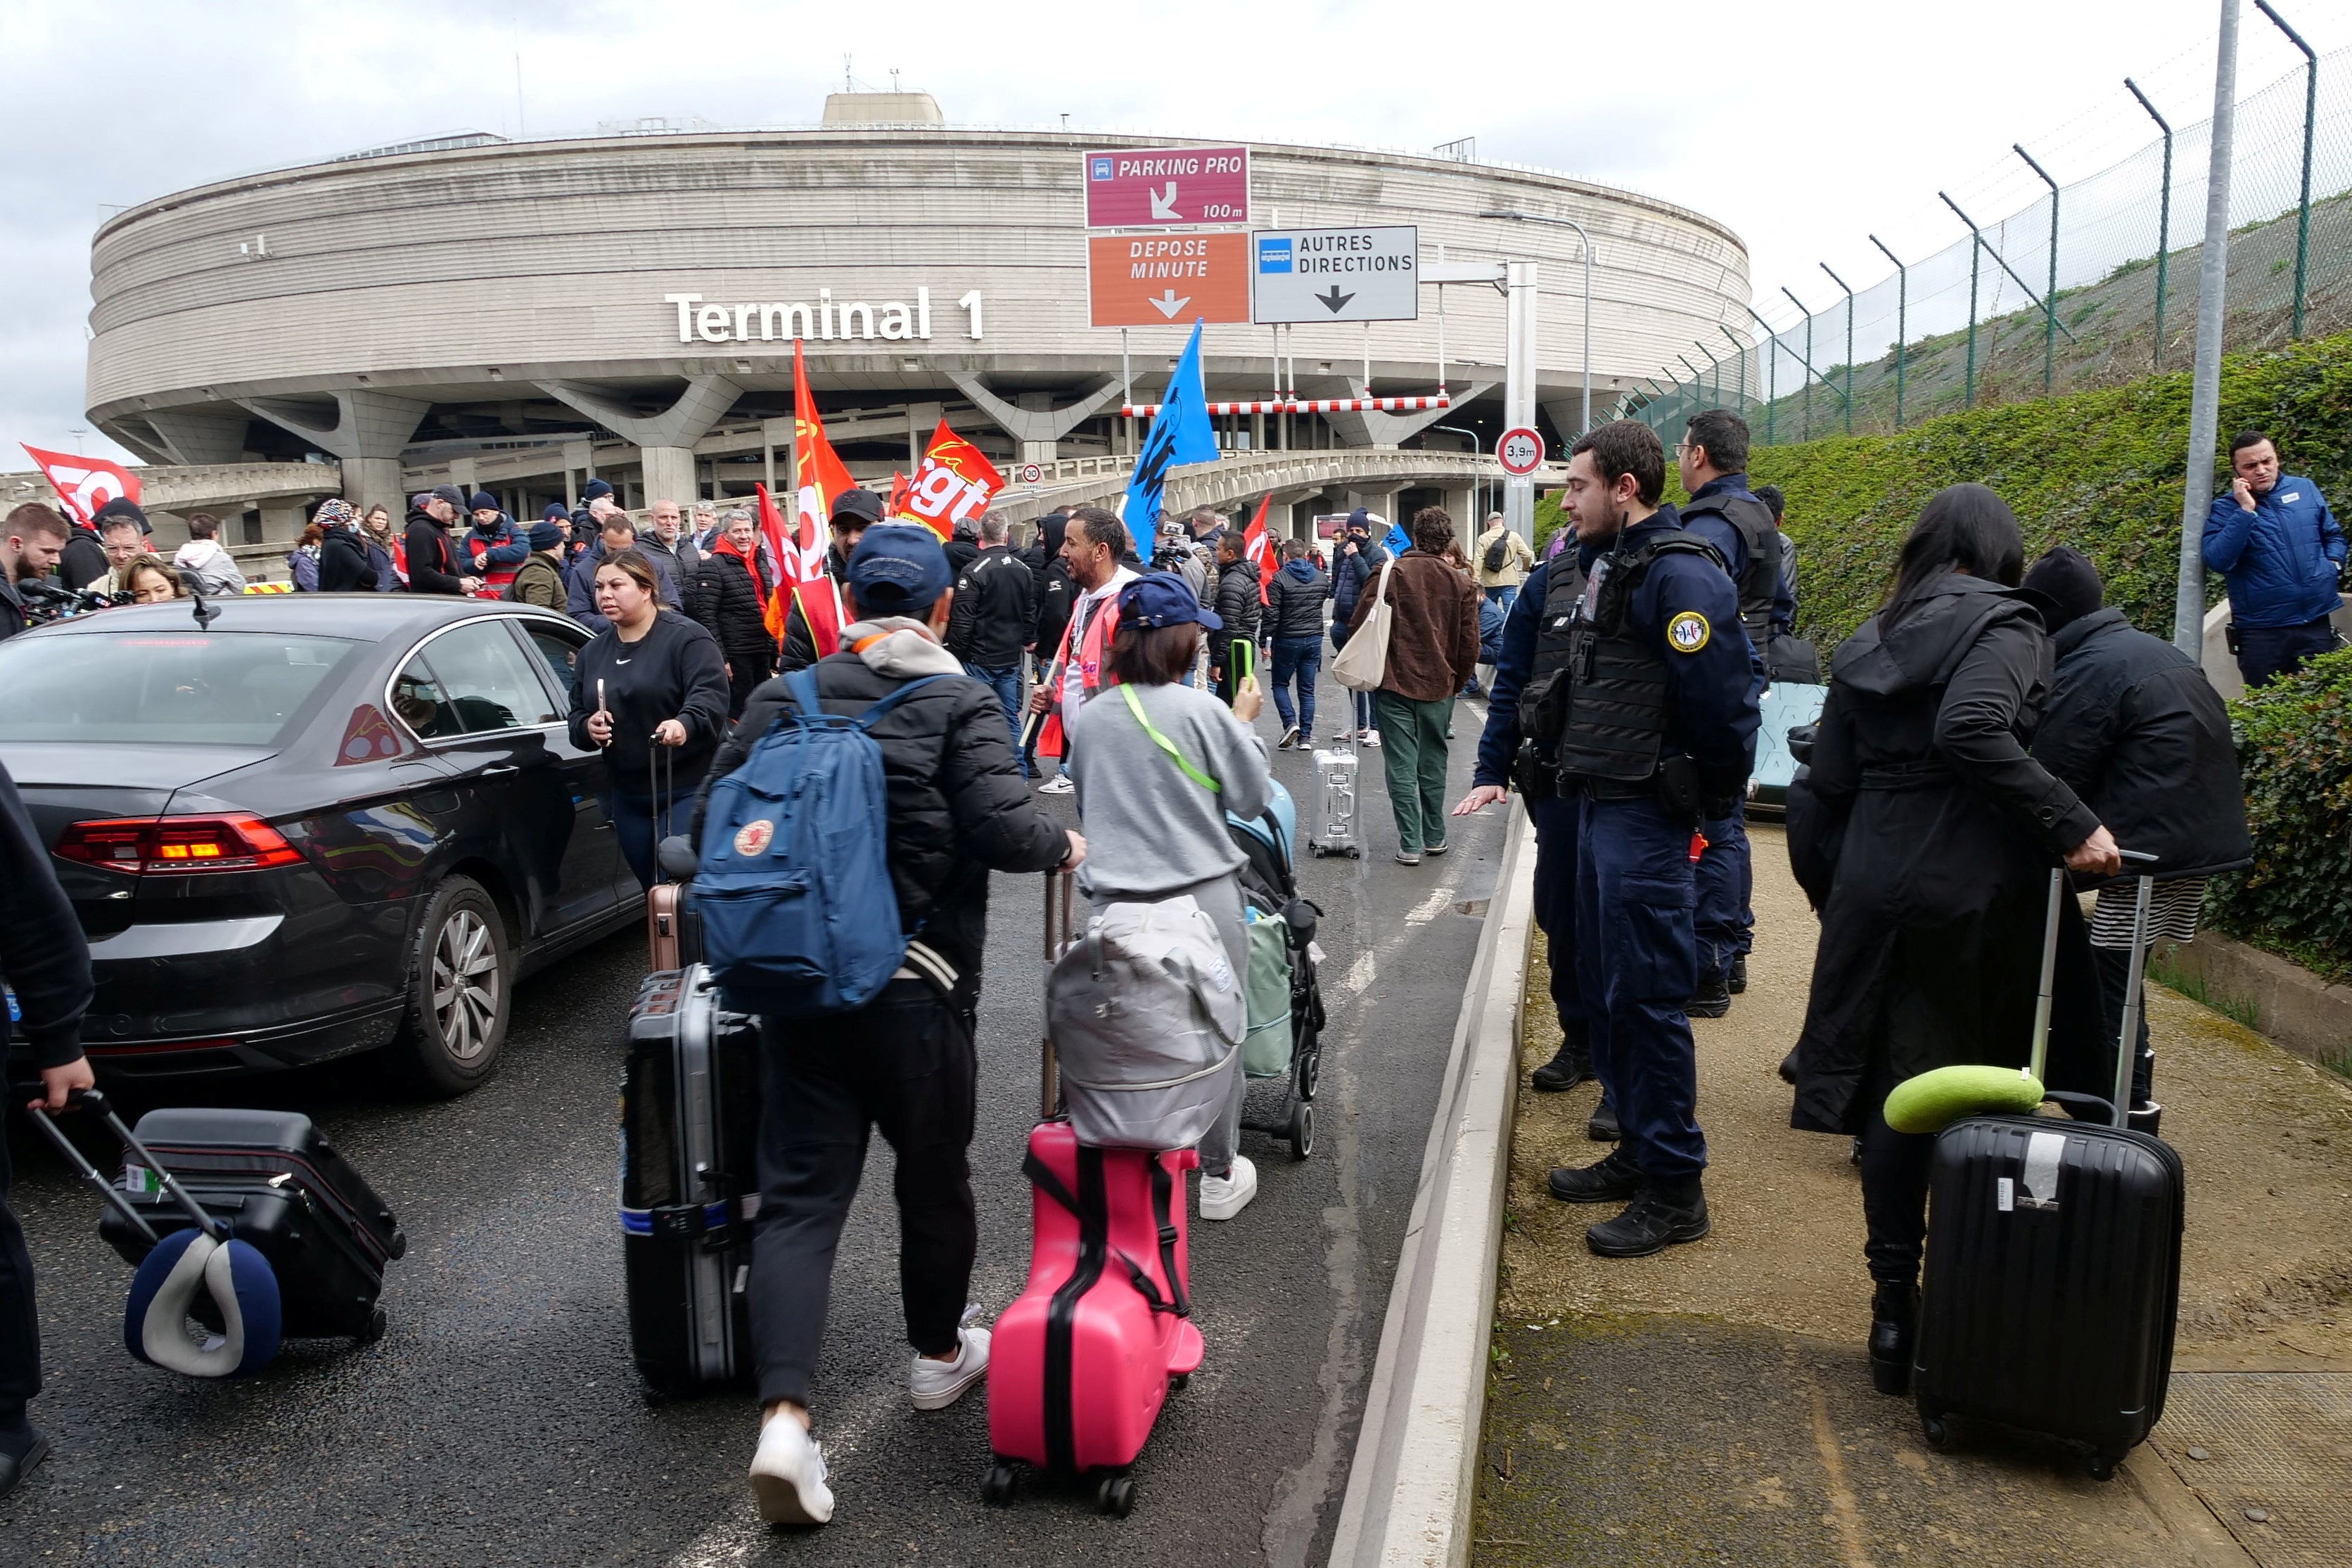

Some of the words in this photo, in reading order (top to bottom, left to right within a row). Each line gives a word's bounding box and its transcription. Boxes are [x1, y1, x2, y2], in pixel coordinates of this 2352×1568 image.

[1119, 159, 1199, 176] PARKING
[1205, 157, 1241, 174] PRO
[1203, 204, 1230, 218] 100
[1130, 240, 1208, 257] DEPOSE
[1300, 235, 1372, 252] AUTRES
[1131, 261, 1208, 278] MINUTE
[1300, 255, 1412, 273] DIRECTIONS
[665, 286, 931, 342] Terminal
[957, 289, 984, 339] 1
